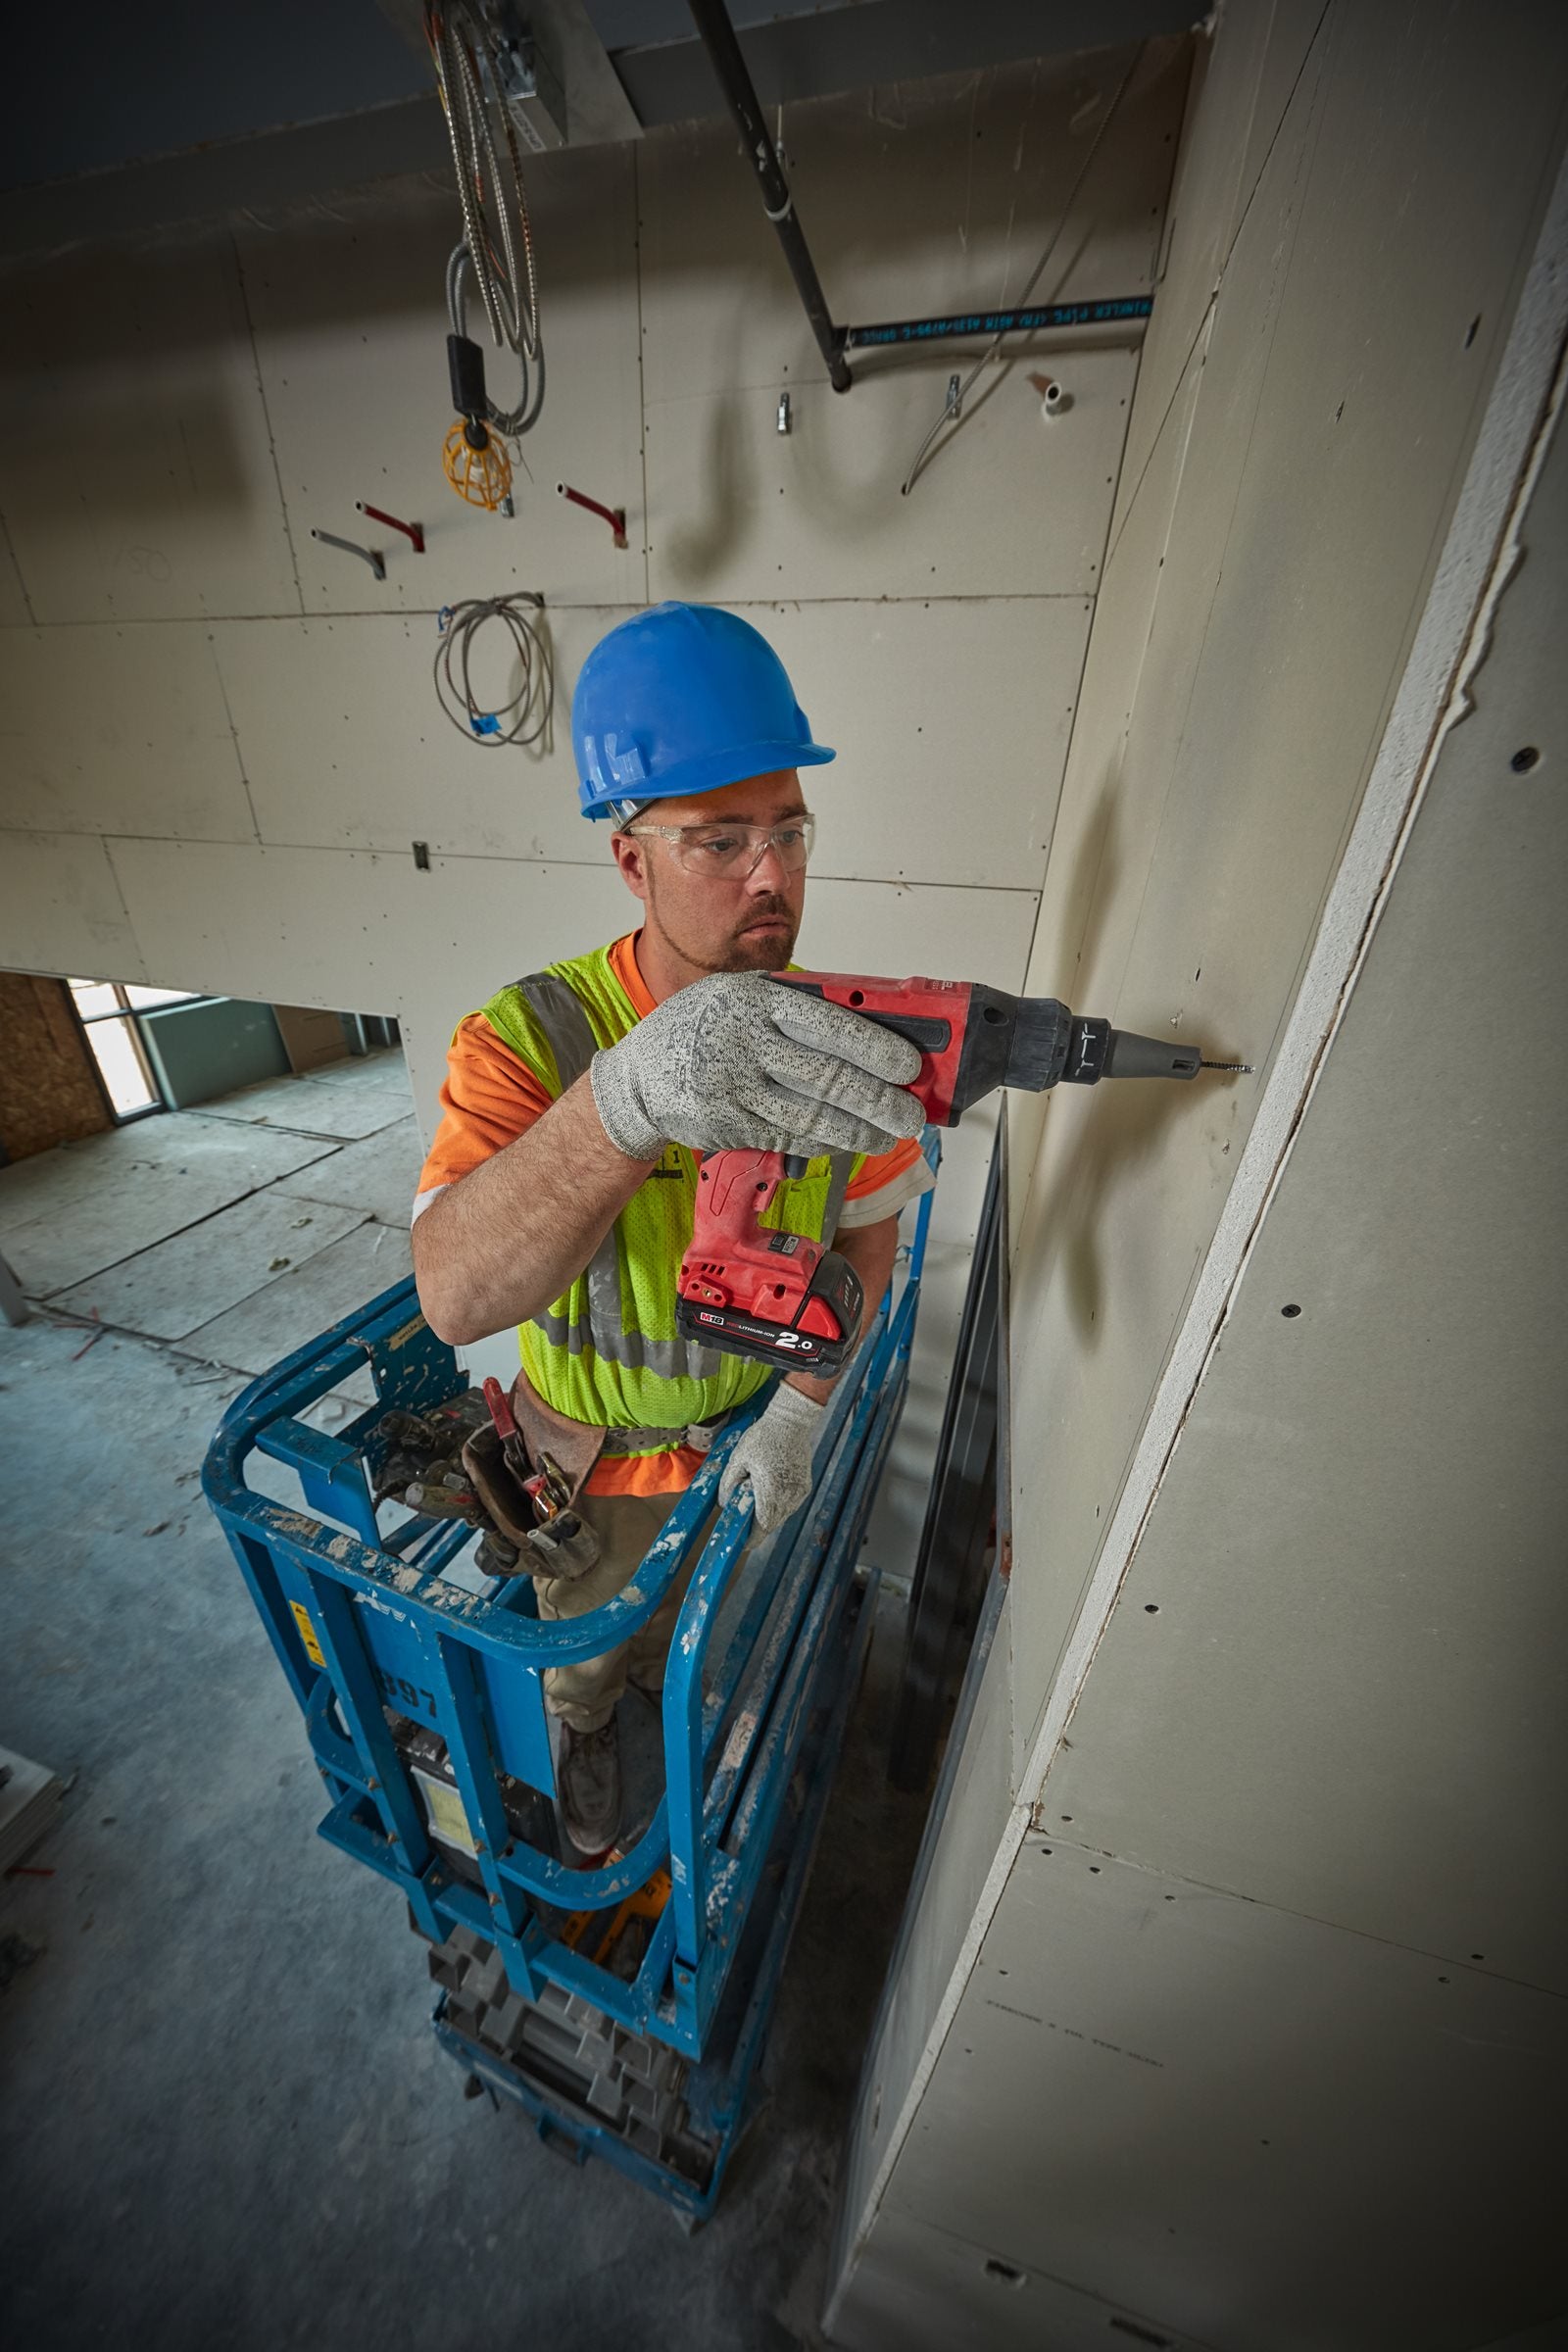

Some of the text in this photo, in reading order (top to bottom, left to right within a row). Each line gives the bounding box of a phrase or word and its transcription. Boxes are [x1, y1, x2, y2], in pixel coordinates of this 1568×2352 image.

[1054, 306, 1090, 324] PIPE
[701, 1312, 723, 1325] M18
[775, 1331, 812, 1349] 2.0
